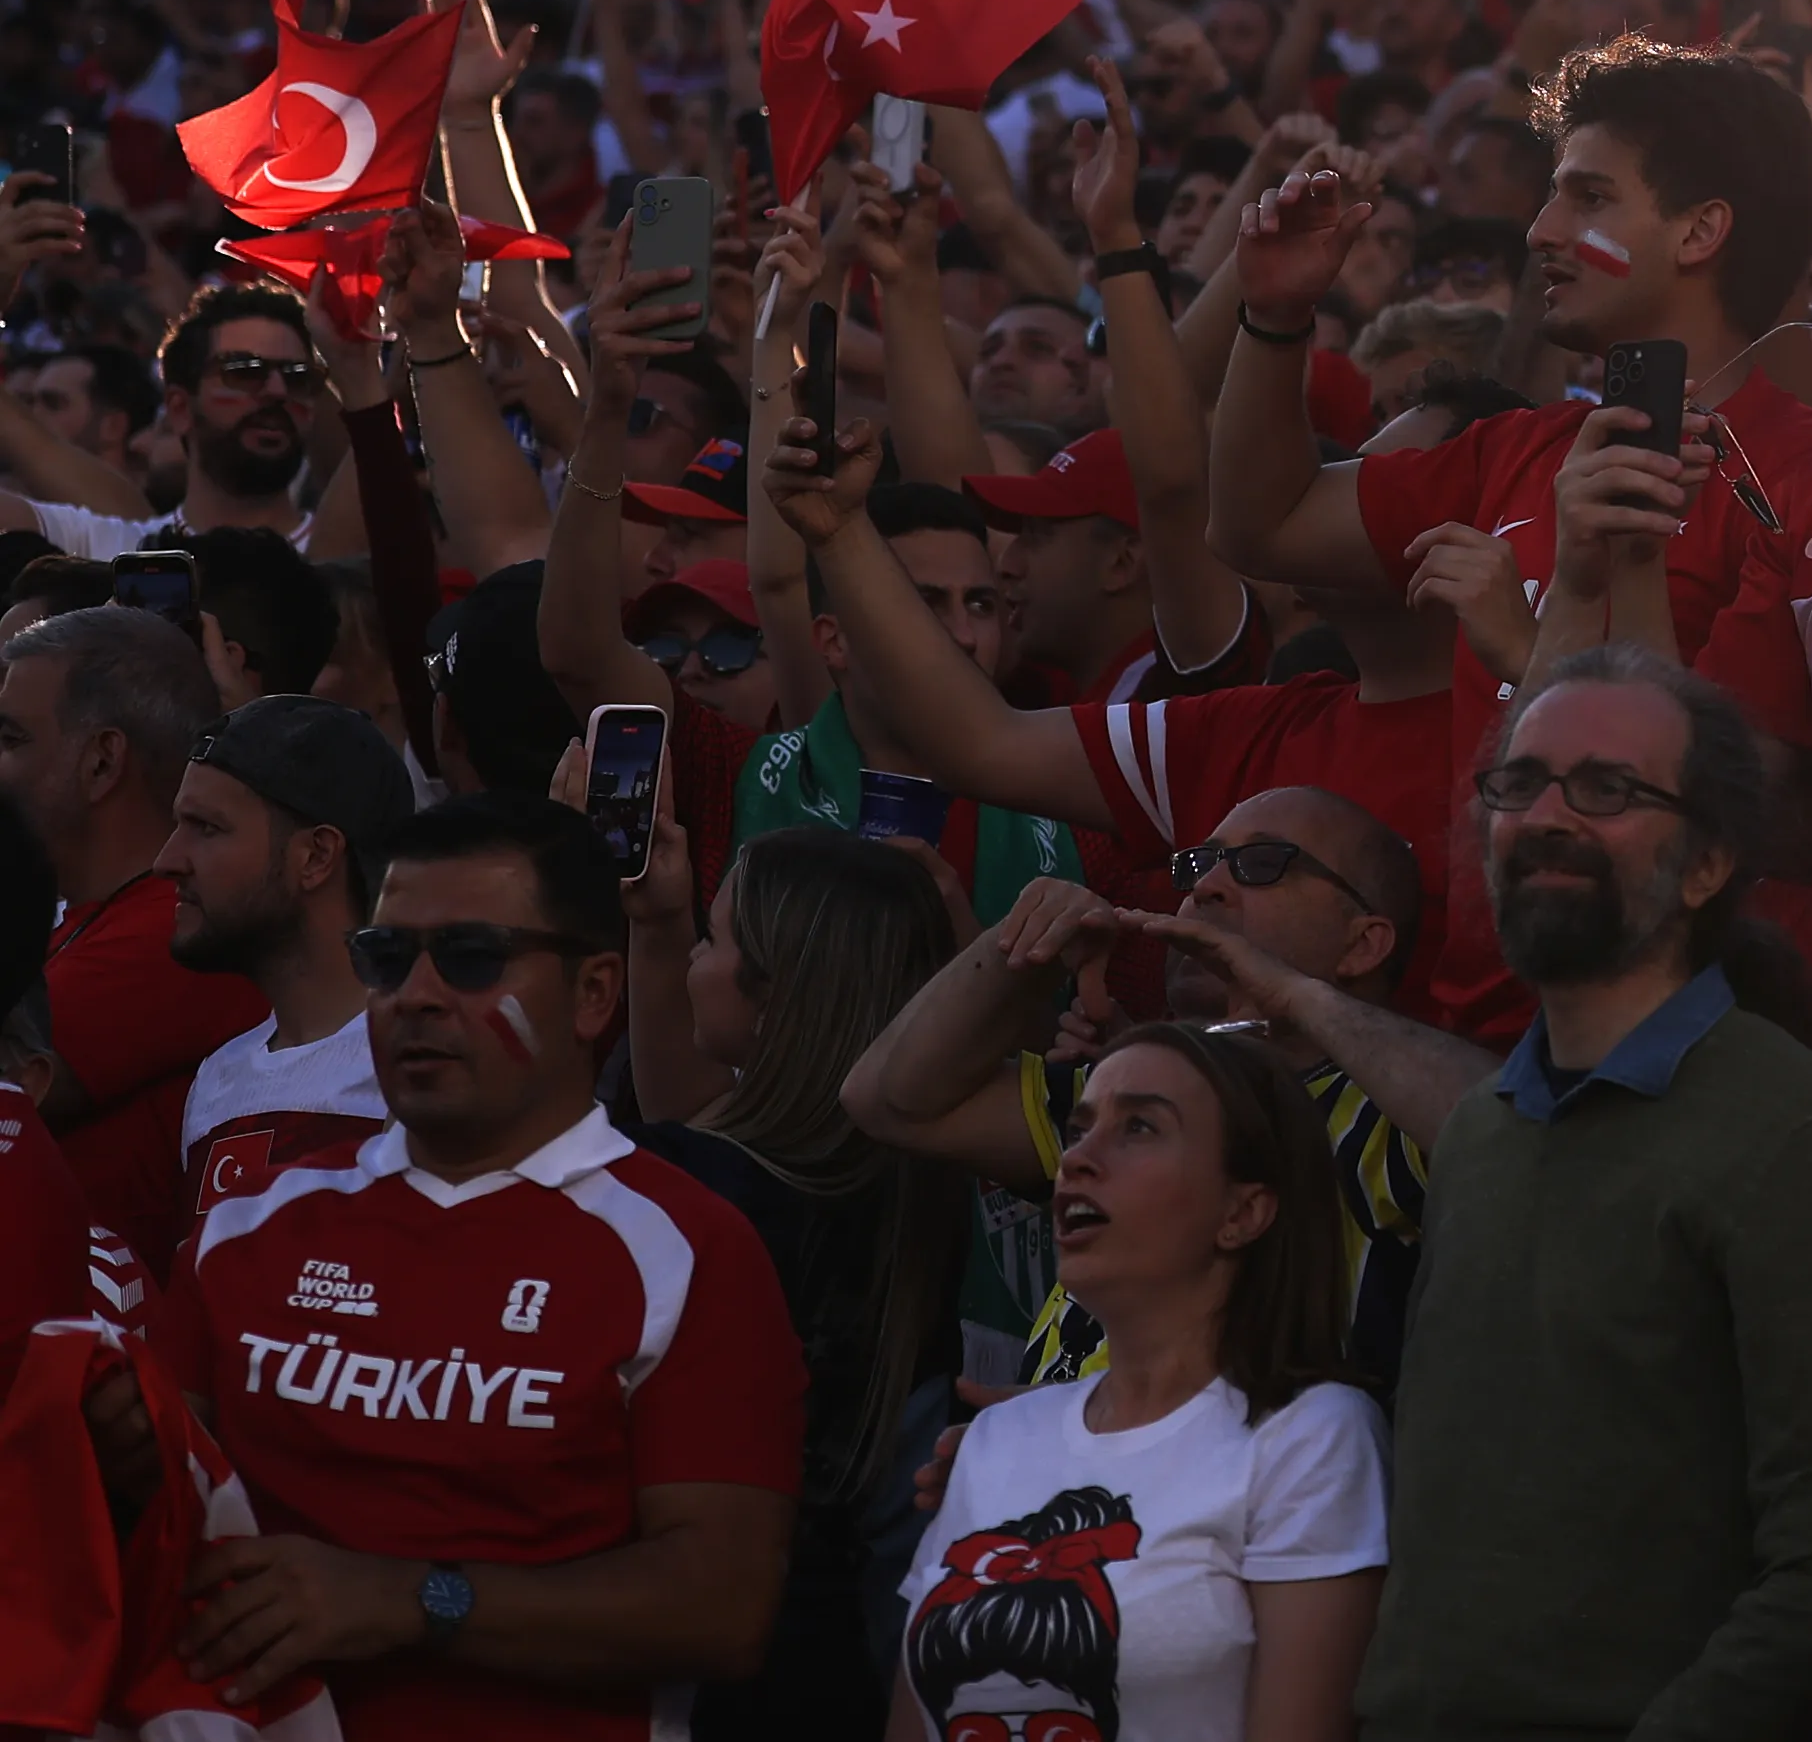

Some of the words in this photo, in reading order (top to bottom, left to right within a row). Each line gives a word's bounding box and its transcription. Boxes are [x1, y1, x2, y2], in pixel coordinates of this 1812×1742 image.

[302, 1258, 351, 1281] FIFA
[296, 1276, 375, 1300] WORLD
[286, 1294, 334, 1311] CUP
[238, 1331, 566, 1430] TÜRKİYE
